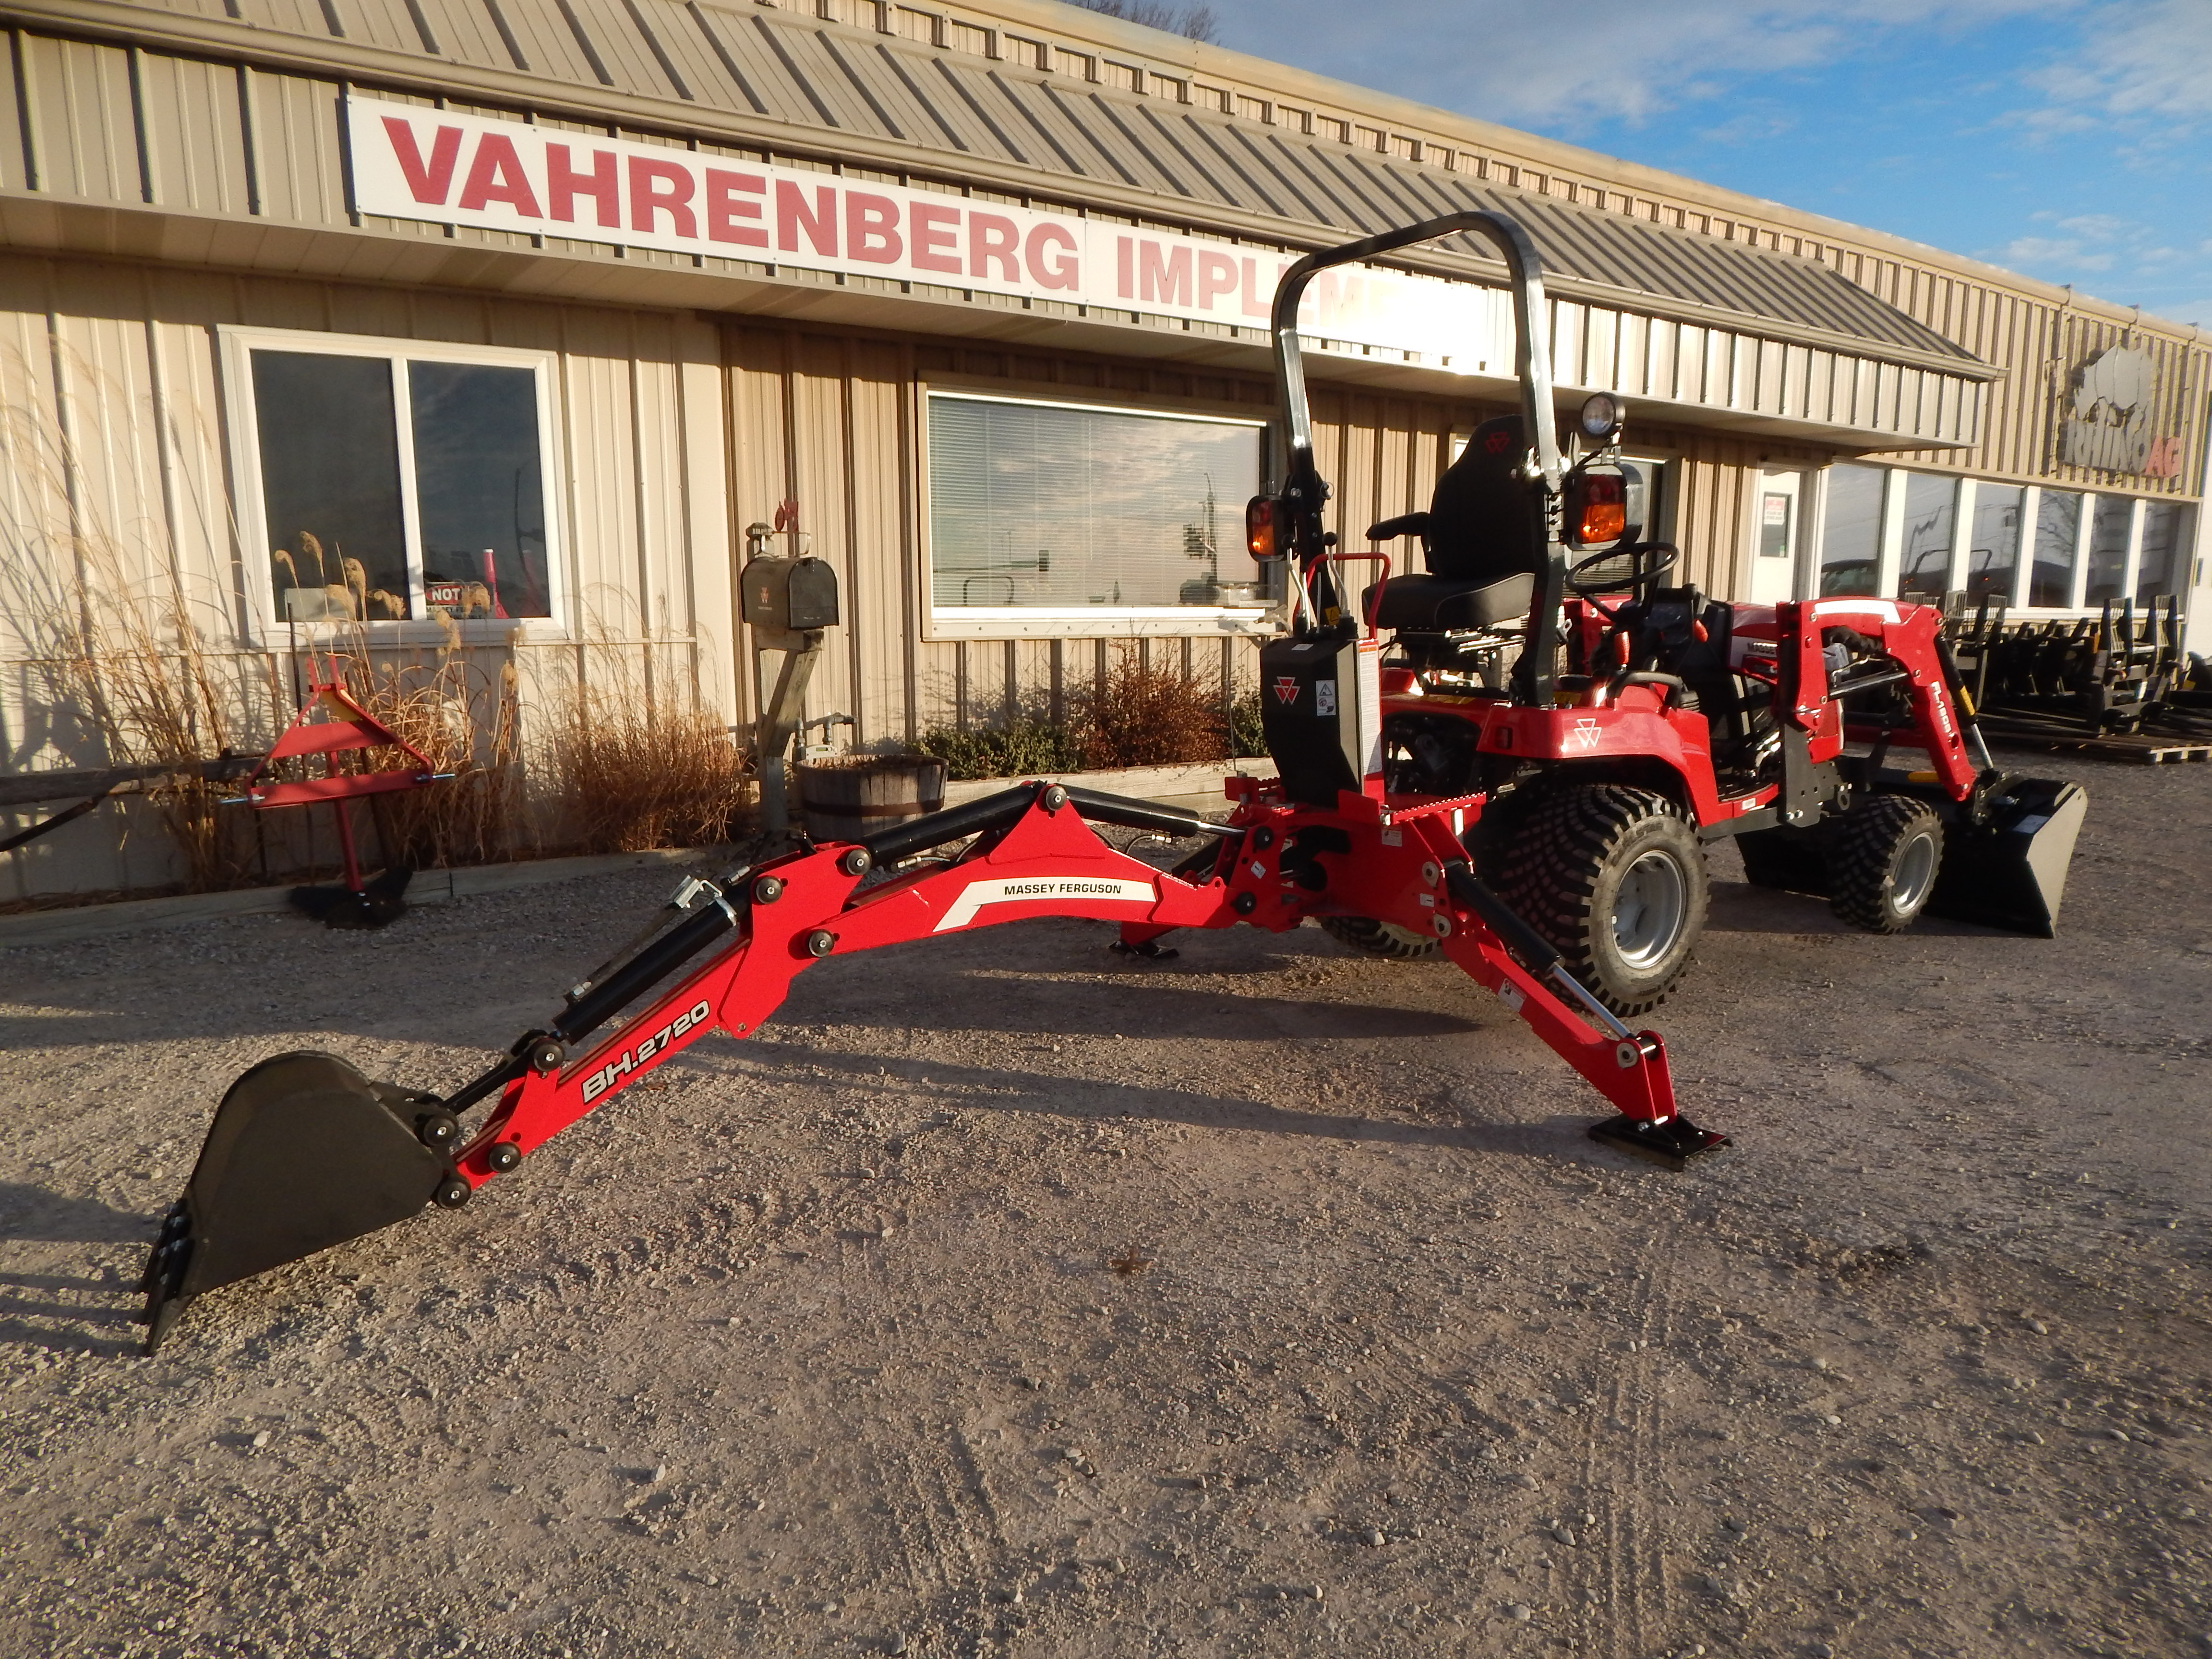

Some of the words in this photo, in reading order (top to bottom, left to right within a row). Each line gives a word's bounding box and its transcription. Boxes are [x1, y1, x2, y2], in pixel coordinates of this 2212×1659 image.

[381, 115, 1080, 291] VAHRENBERG
[1004, 884, 1056, 895] MASSEY
[1059, 883, 1121, 894] FERGUSON
[582, 1000, 709, 1104] BH.2720
